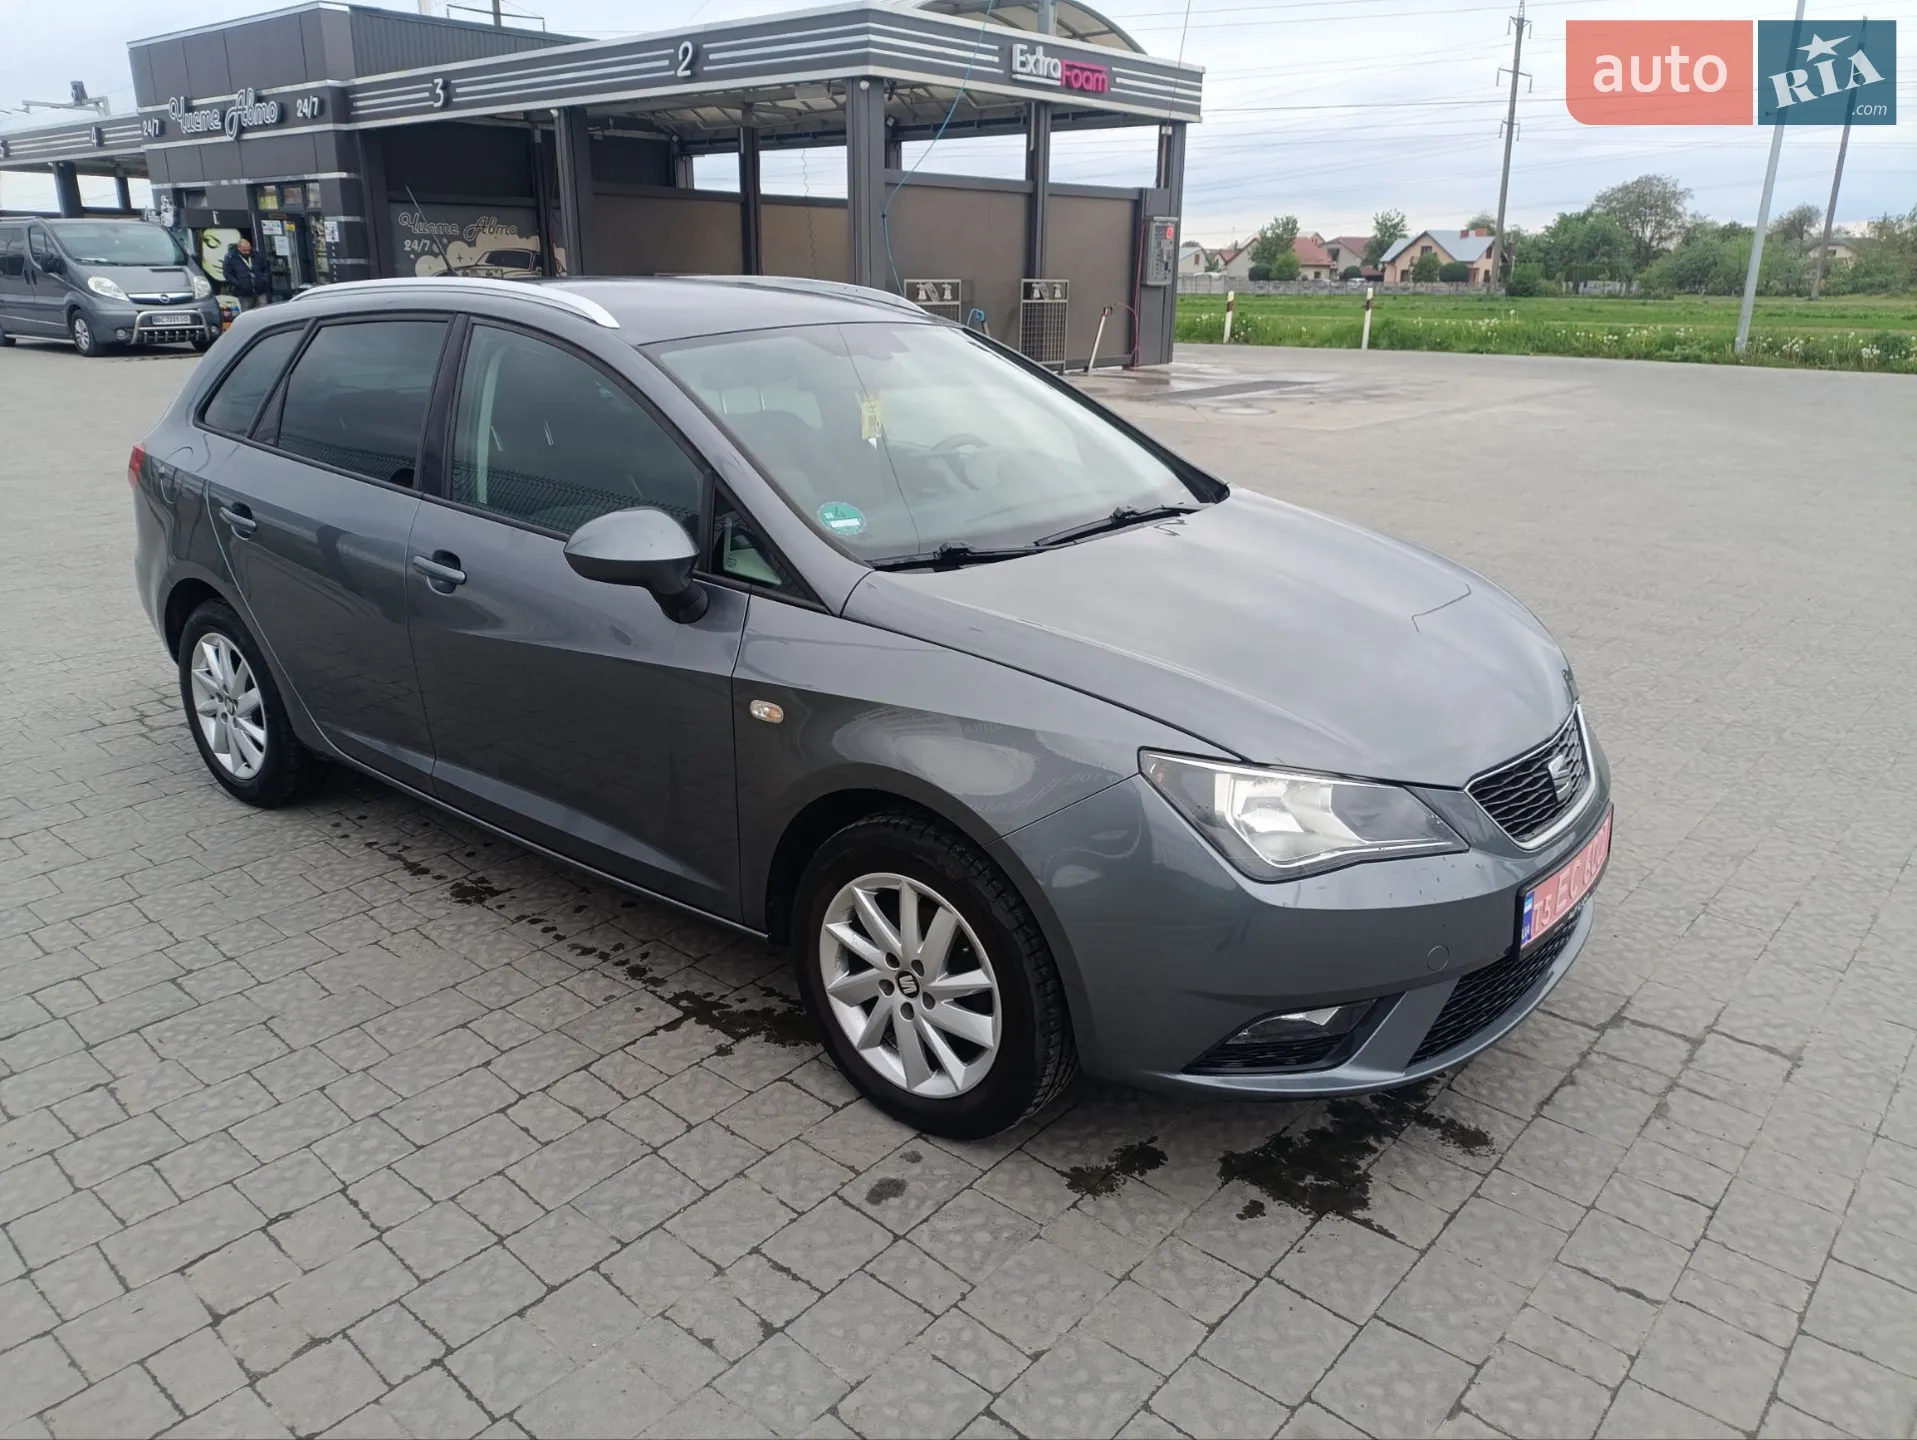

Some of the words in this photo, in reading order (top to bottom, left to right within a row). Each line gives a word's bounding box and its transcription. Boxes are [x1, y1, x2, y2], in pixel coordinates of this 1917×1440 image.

[676, 41, 693, 77] 2
[1012, 43, 1061, 79] Extra
[1062, 60, 1109, 93] Foam
[433, 78, 445, 108] 3
[142, 118, 160, 137] 24/7
[168, 96, 222, 134] Чисте
[224, 87, 279, 140] Авто
[296, 95, 320, 118] 24/7
[403, 239, 431, 253] 24/7
